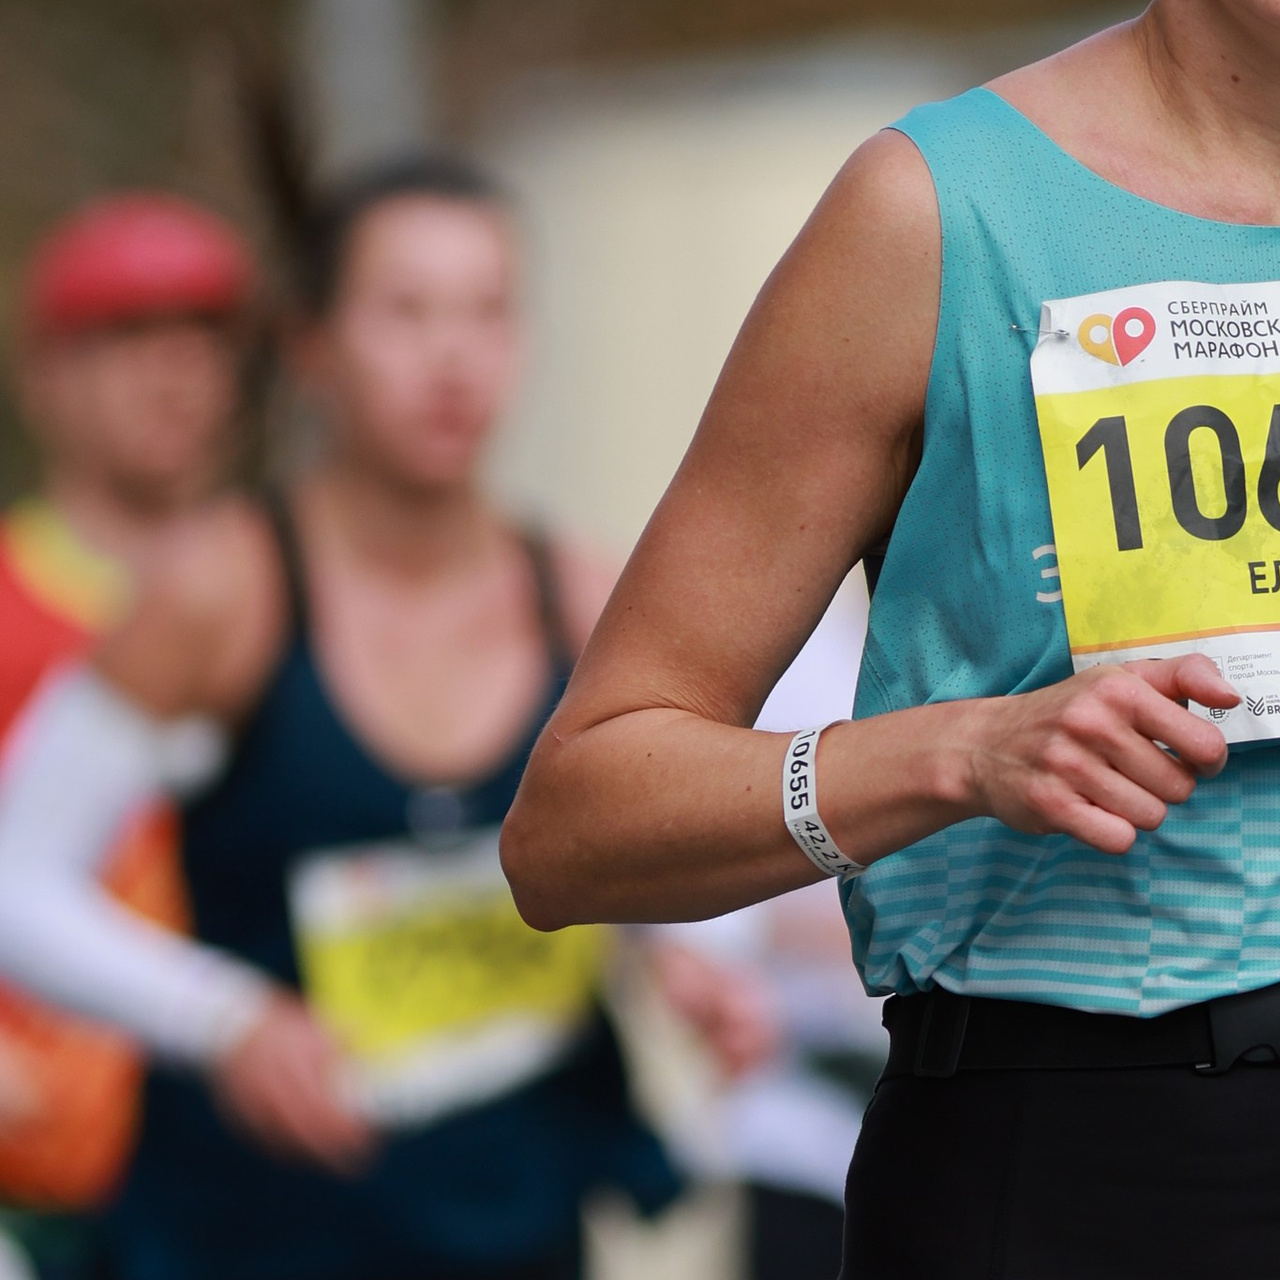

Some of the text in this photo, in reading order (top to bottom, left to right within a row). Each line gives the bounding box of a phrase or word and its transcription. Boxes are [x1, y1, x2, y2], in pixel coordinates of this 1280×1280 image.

[1167, 300, 1268, 316] СБЕРПРАЙМ
[1173, 340, 1279, 359] МАРАФОН
[1227, 653, 1272, 663] Департамент
[1229, 663, 1253, 671] спорта
[1230, 671, 1255, 680] города
[790, 730, 816, 810] 10655
[804, 821, 839, 860] 42,2
